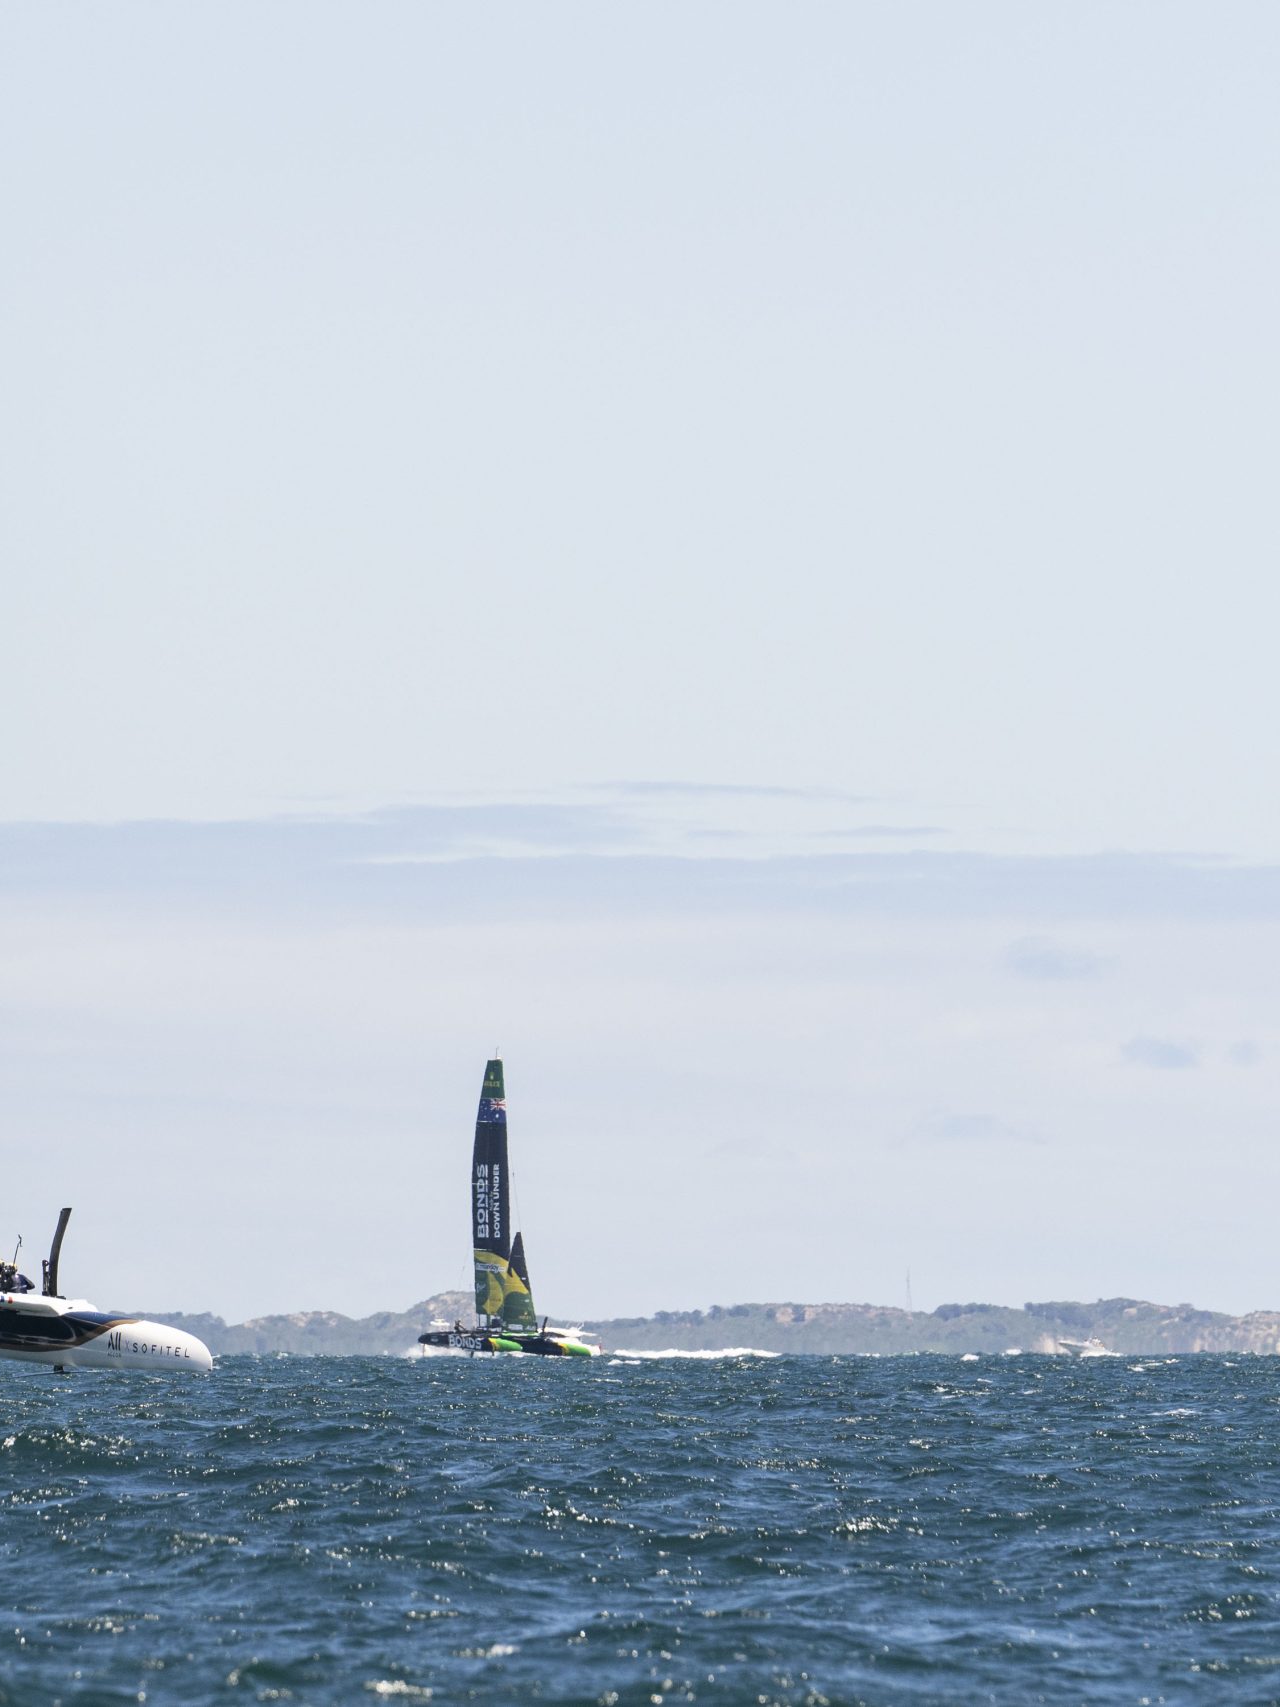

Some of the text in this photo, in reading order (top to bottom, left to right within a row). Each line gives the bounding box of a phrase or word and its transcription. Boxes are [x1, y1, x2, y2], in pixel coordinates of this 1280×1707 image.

[476, 1163, 489, 1238] BONDS
[492, 1163, 501, 1238] DOWN UNDER
[132, 1342, 190, 1358] SOFITEL
[448, 1335, 482, 1350] BONDS
